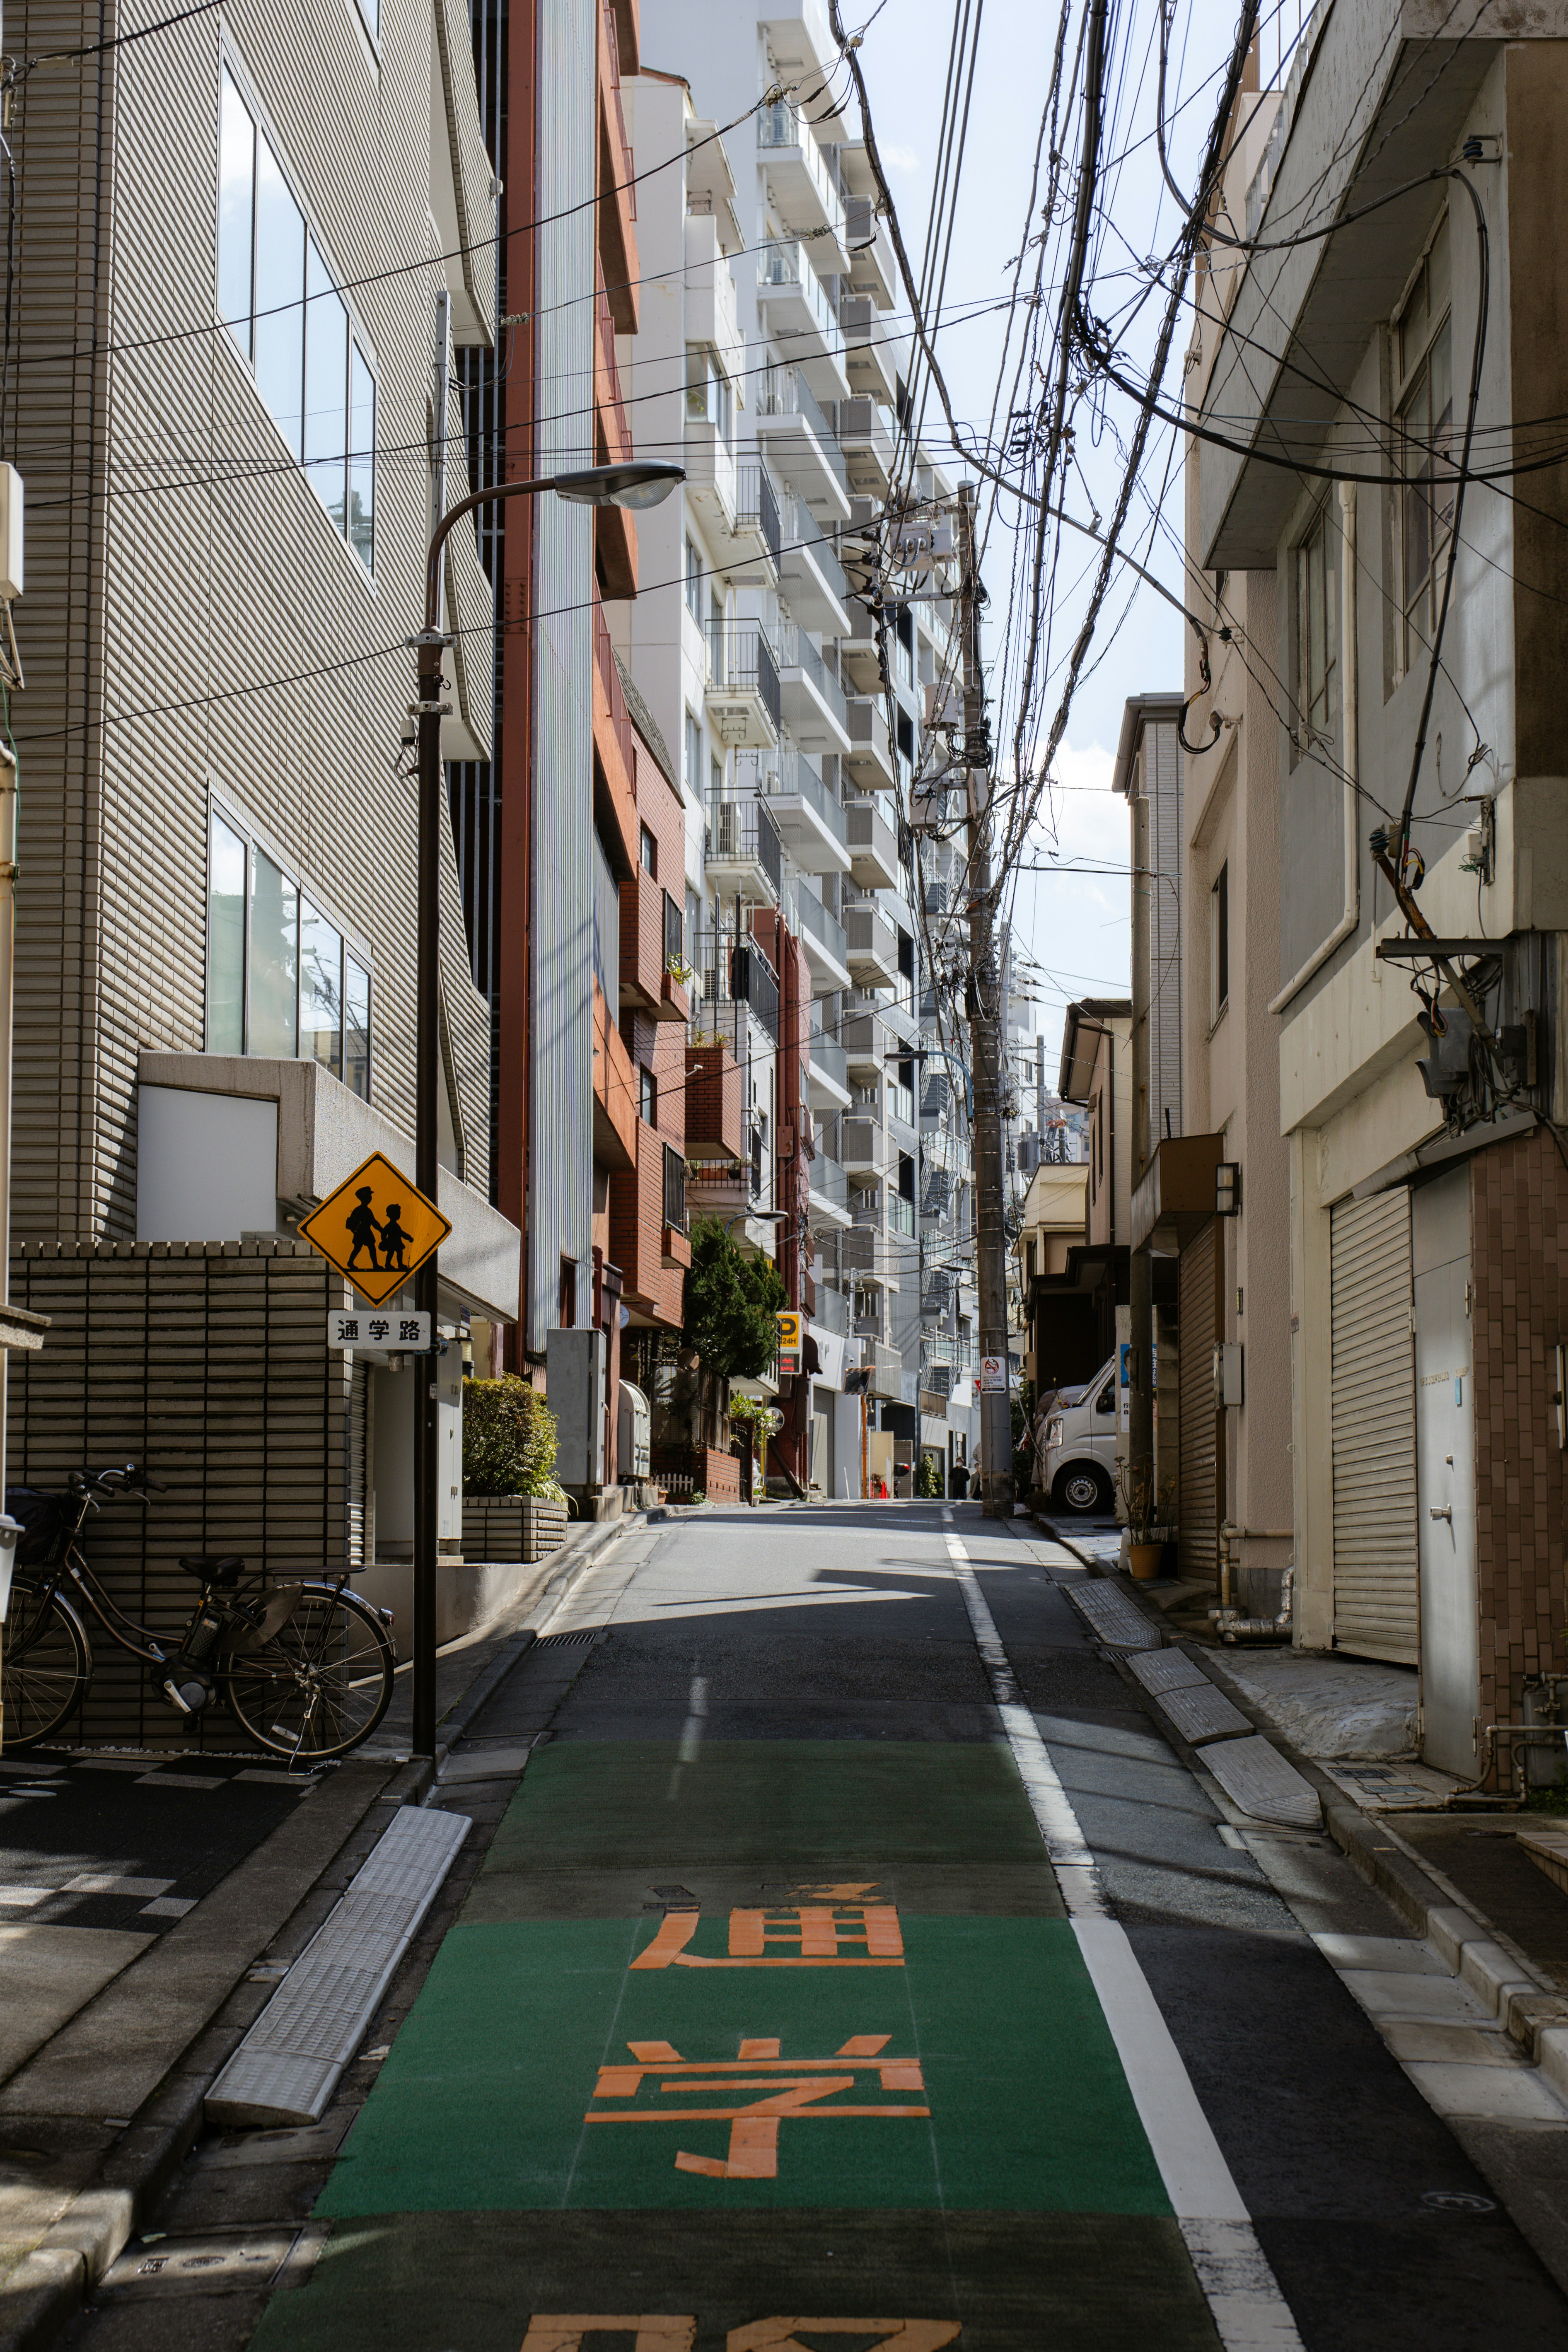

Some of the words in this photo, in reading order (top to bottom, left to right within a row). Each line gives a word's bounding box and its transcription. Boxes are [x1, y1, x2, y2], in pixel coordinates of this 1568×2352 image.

[338, 1320, 420, 1340] 通学路
[80, 1582, 93, 1601] Panasonic
